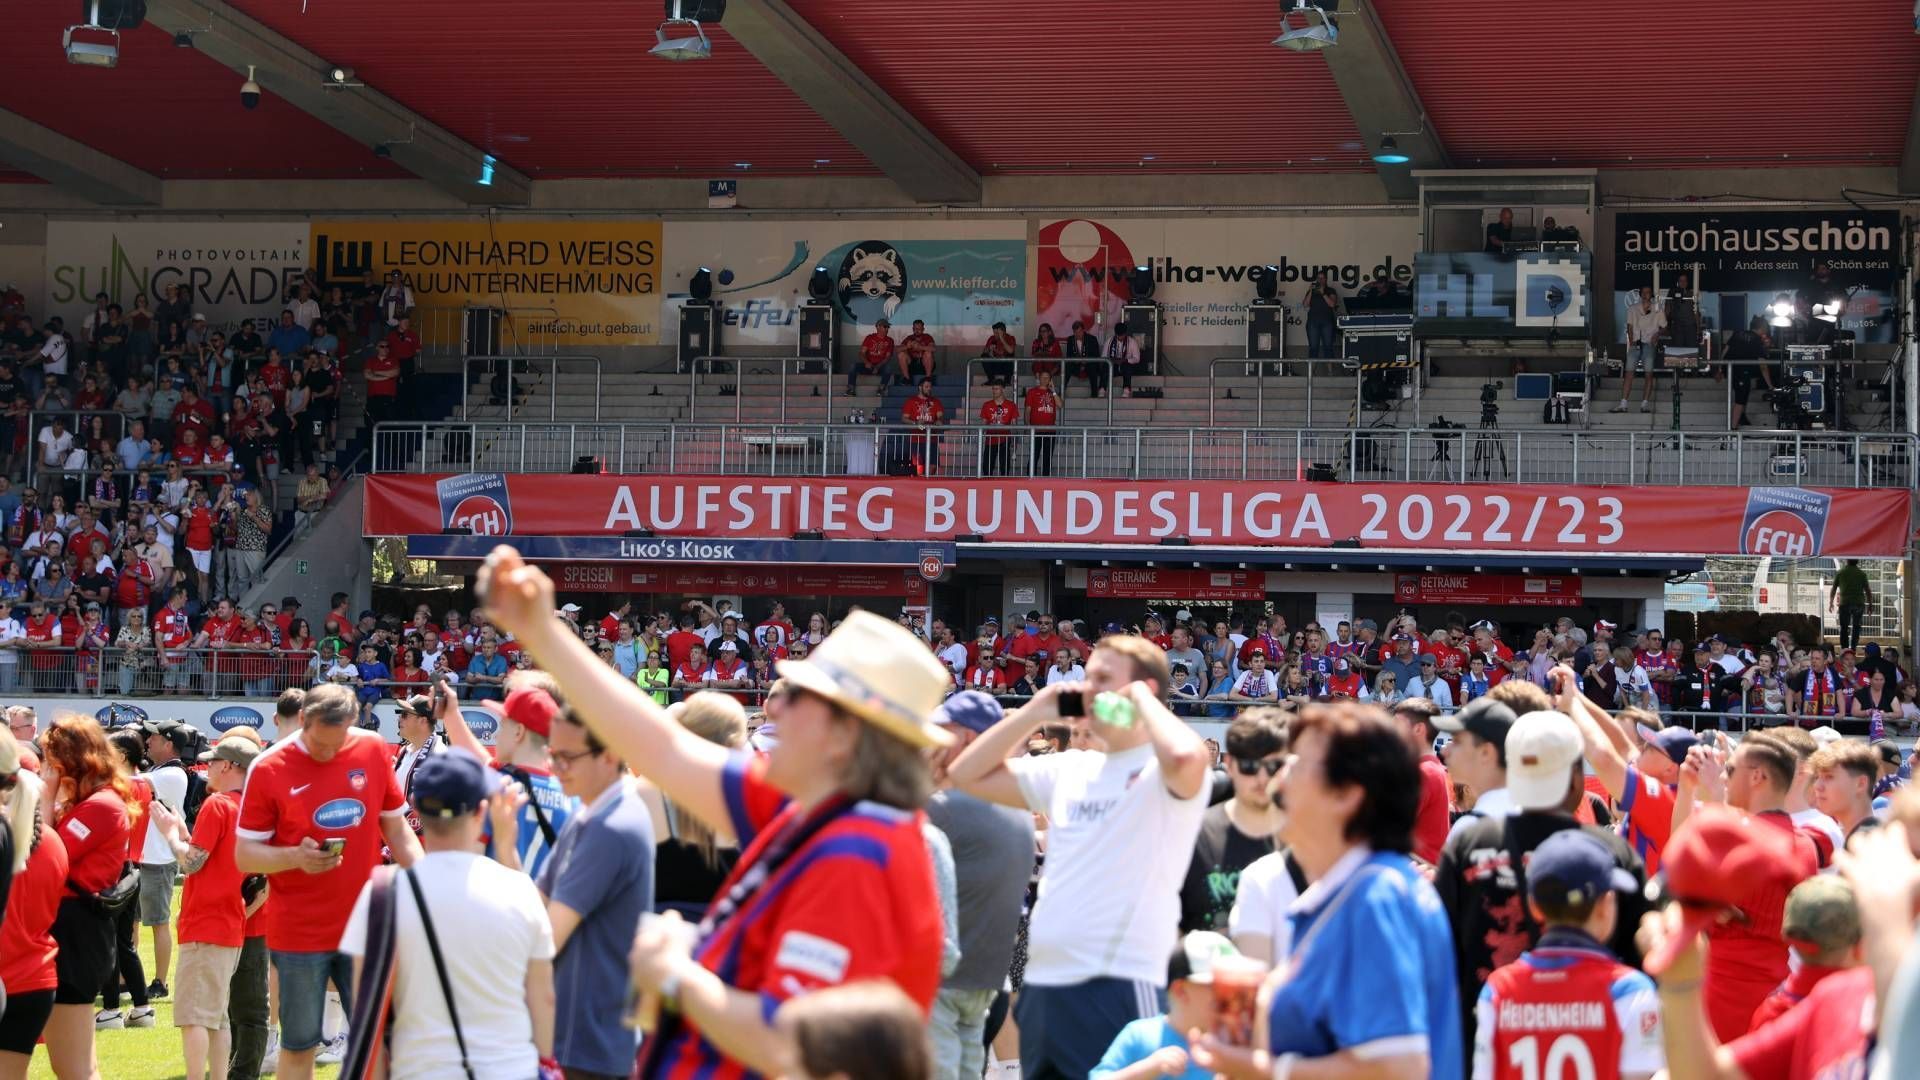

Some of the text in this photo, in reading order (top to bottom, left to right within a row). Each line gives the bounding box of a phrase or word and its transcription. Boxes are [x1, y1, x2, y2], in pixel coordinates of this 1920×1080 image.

[156, 250, 301, 261] PHOTOVOLTAIK
[384, 241, 655, 266] LEONHARD WEISS
[1734, 259, 1773, 270] Anders
[1777, 259, 1799, 270] sein
[1827, 258, 1861, 270] Schön
[1865, 258, 1889, 269] sein
[912, 276, 1018, 290] www.kieffer.de
[528, 320, 651, 337] einfach.gut.gebaut
[485, 480, 502, 489] 1846
[604, 484, 1625, 545] AUFSTIEG BUNDESLIGA 2022/23
[1804, 504, 1823, 515] 1846
[1754, 527, 1806, 555] FCH
[681, 541, 735, 559] KIOSK
[564, 566, 614, 583] SPEISEN
[1112, 569, 1158, 584] GETRÄNKE
[1421, 575, 1469, 589] GETRÄNKE
[214, 717, 259, 725] HARTMANN
[319, 806, 361, 820] HARTMANN
[1500, 1000, 1606, 1030] HEIDENHEIM
[1509, 1033, 1598, 1080] 10
